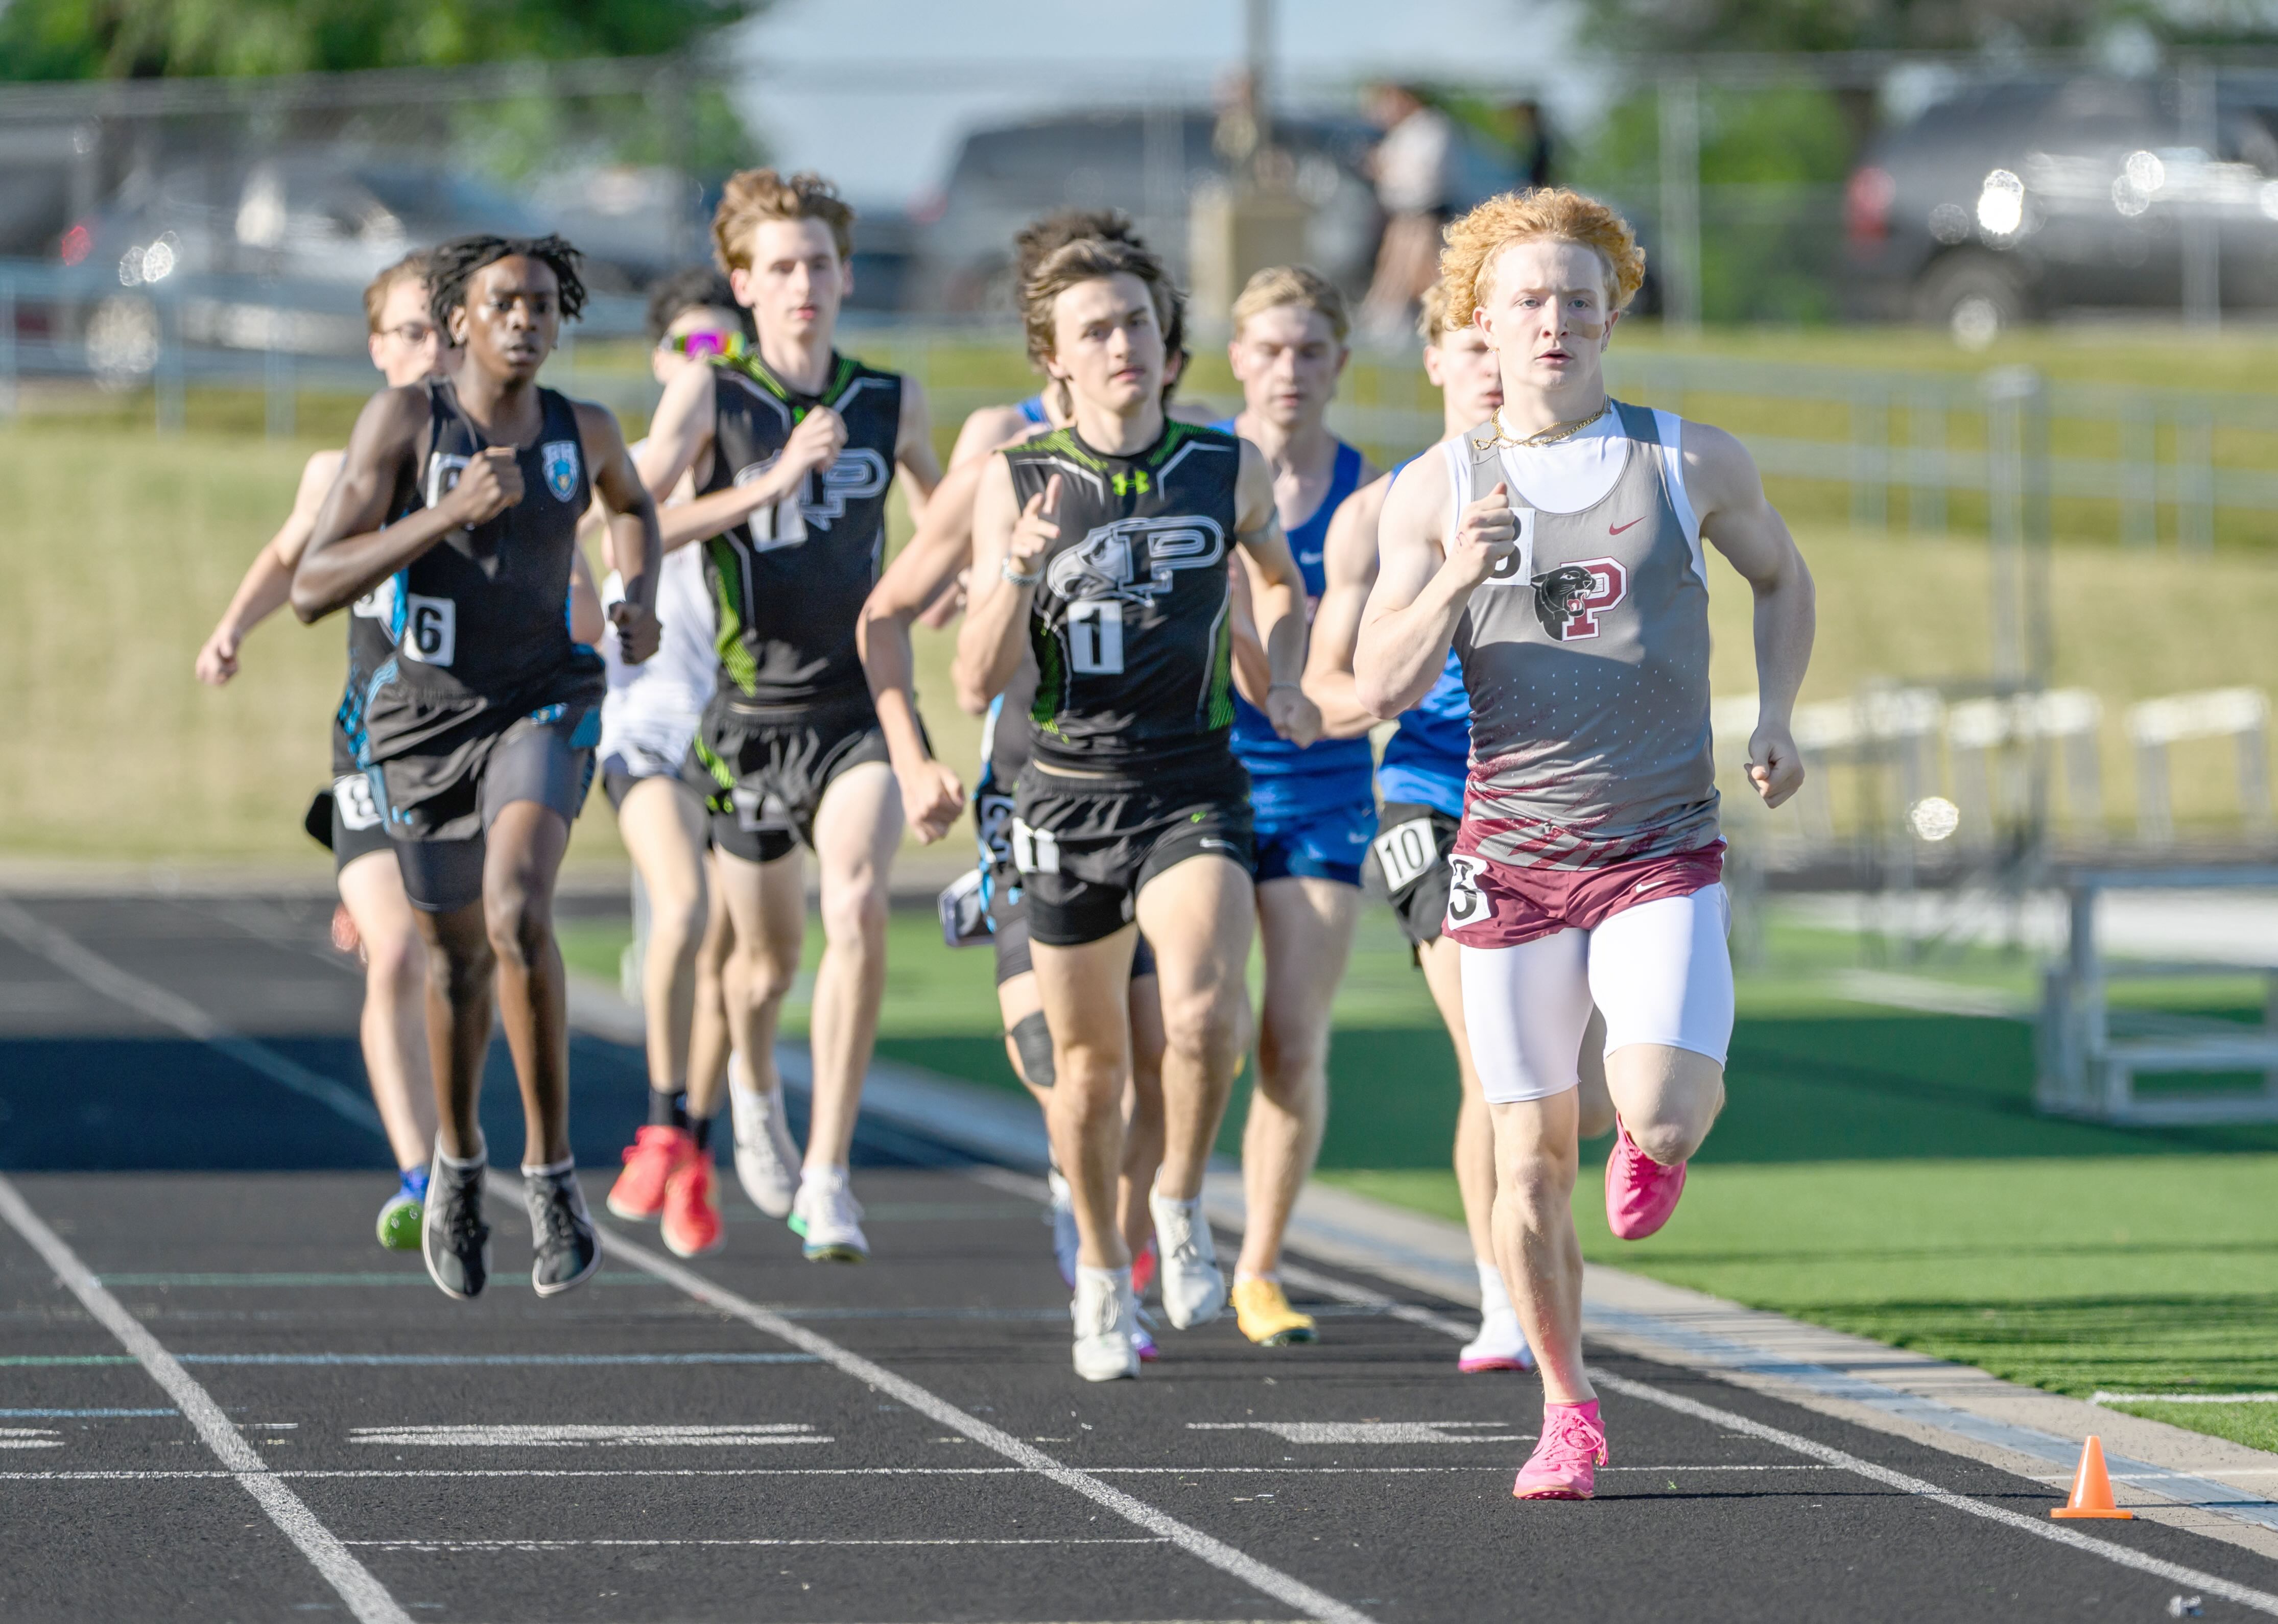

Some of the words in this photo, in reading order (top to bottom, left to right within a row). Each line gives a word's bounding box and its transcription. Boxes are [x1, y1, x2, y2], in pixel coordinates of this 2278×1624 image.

[1561, 556, 1629, 642] P
[416, 606, 442, 654] 6
[1078, 606, 1102, 666] 1
[1385, 828, 1424, 879] 10
[1450, 858, 1478, 921] 3
